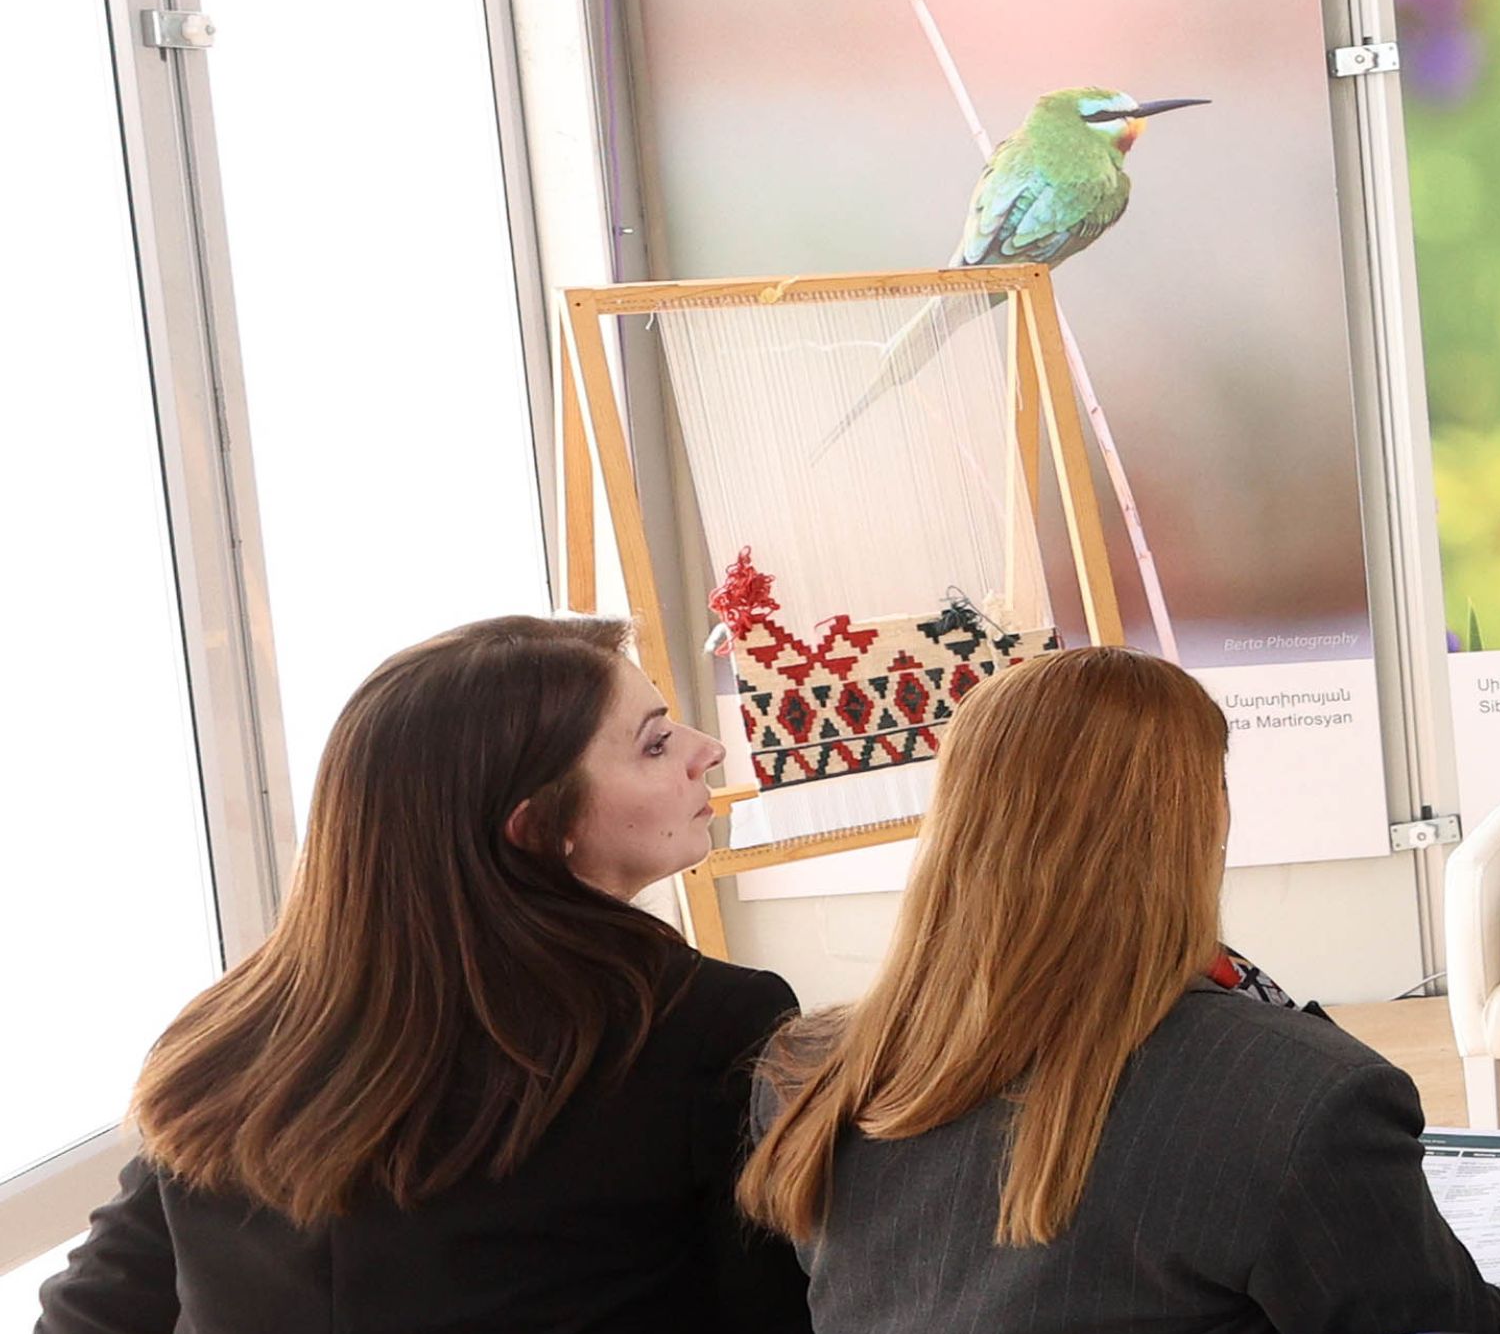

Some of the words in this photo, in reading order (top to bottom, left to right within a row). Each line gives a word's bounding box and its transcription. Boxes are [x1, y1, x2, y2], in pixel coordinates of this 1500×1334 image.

[1224, 637, 1263, 652] Berta
[1266, 632, 1359, 650] Photography
[1225, 688, 1352, 709] Մարտիրոսյան
[1256, 712, 1353, 730] Martirosyan
